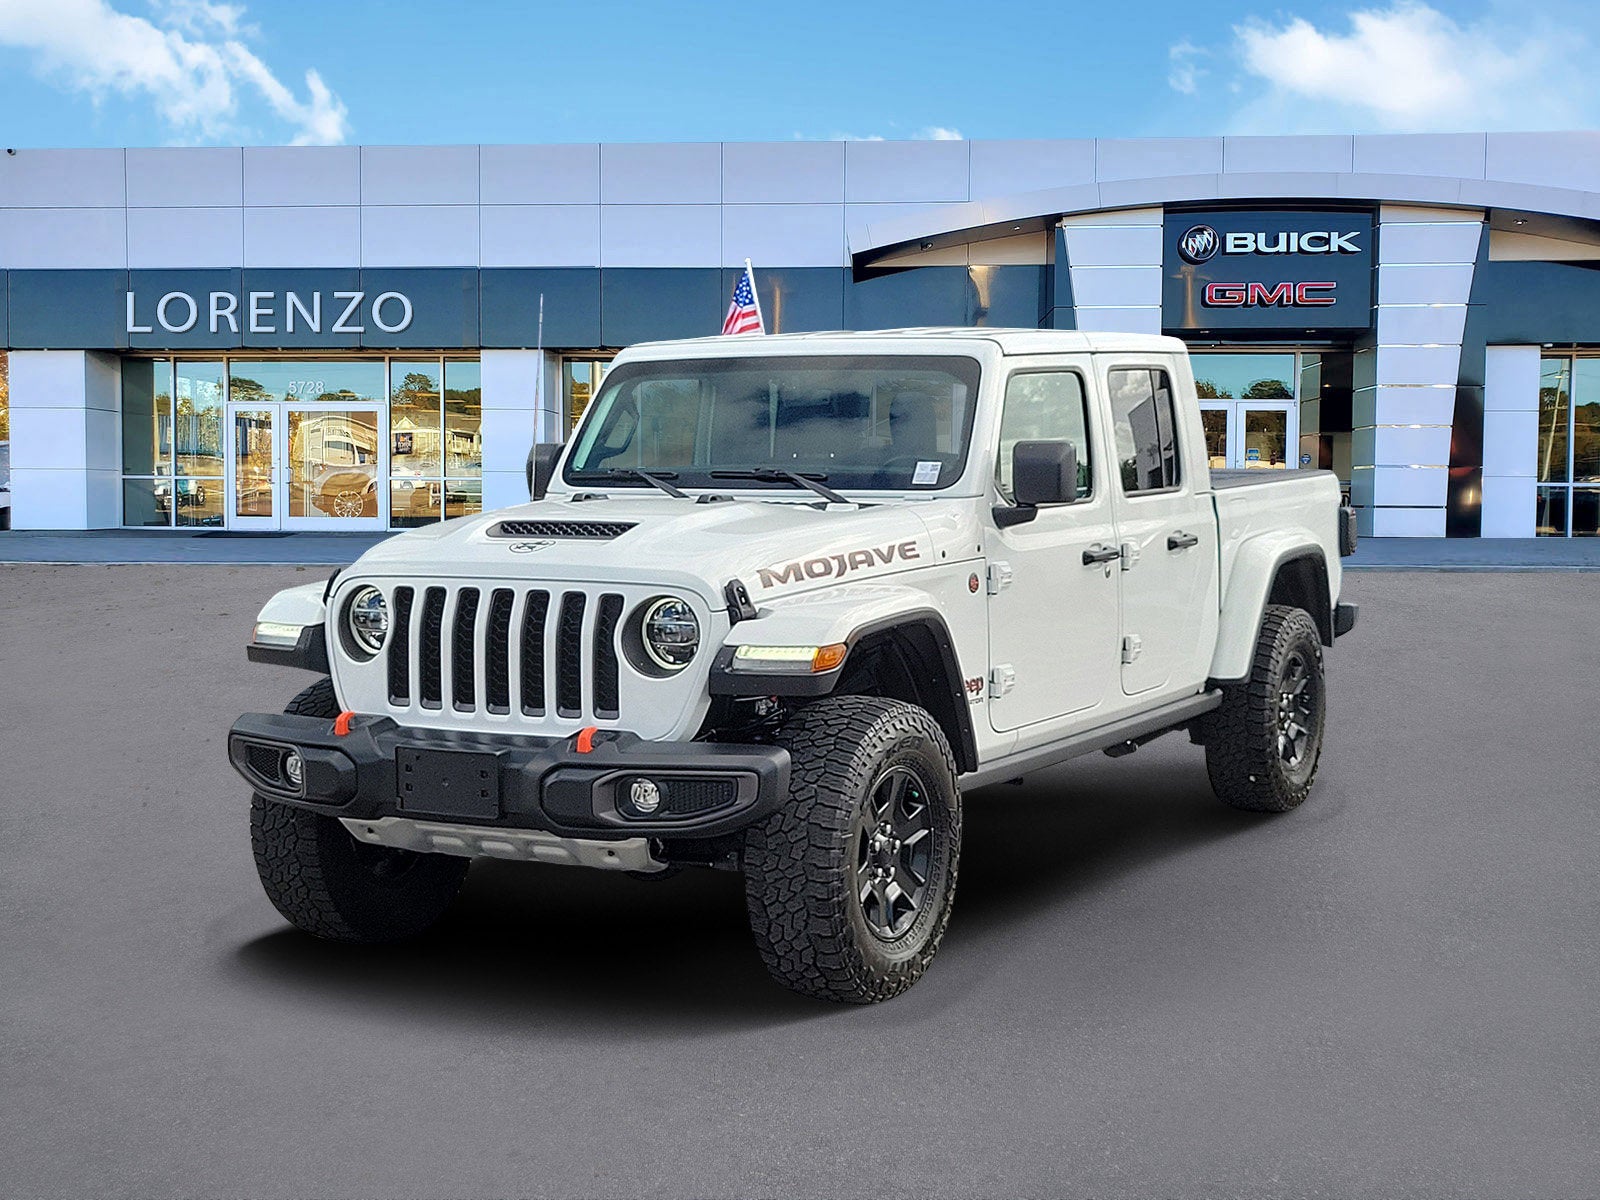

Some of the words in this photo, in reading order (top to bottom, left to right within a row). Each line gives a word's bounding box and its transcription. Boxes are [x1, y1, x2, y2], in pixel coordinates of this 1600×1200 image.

[1225, 231, 1362, 253] BUICK
[1205, 281, 1337, 305] GMC
[126, 290, 414, 333] LORENZO
[289, 381, 325, 394] 5728
[756, 540, 921, 589] MOJAVE
